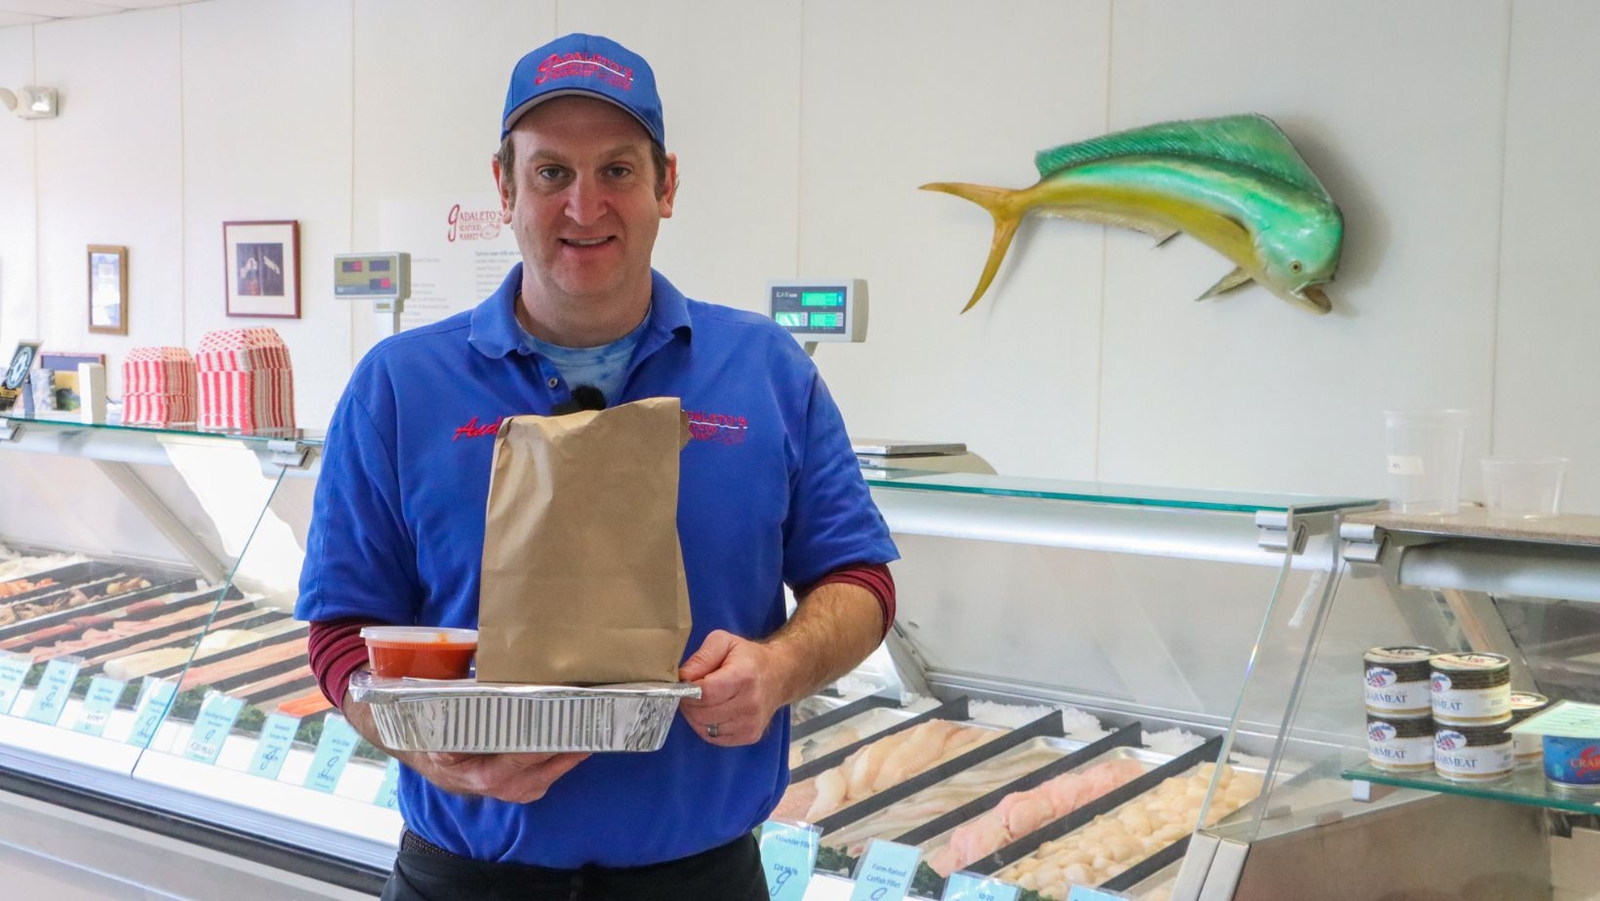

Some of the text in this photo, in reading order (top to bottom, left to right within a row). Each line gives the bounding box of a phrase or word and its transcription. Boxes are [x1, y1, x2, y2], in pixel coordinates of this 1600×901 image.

[872, 863, 907, 877] Farm-Raised
[866, 874, 902, 889] Catfish Fillet
